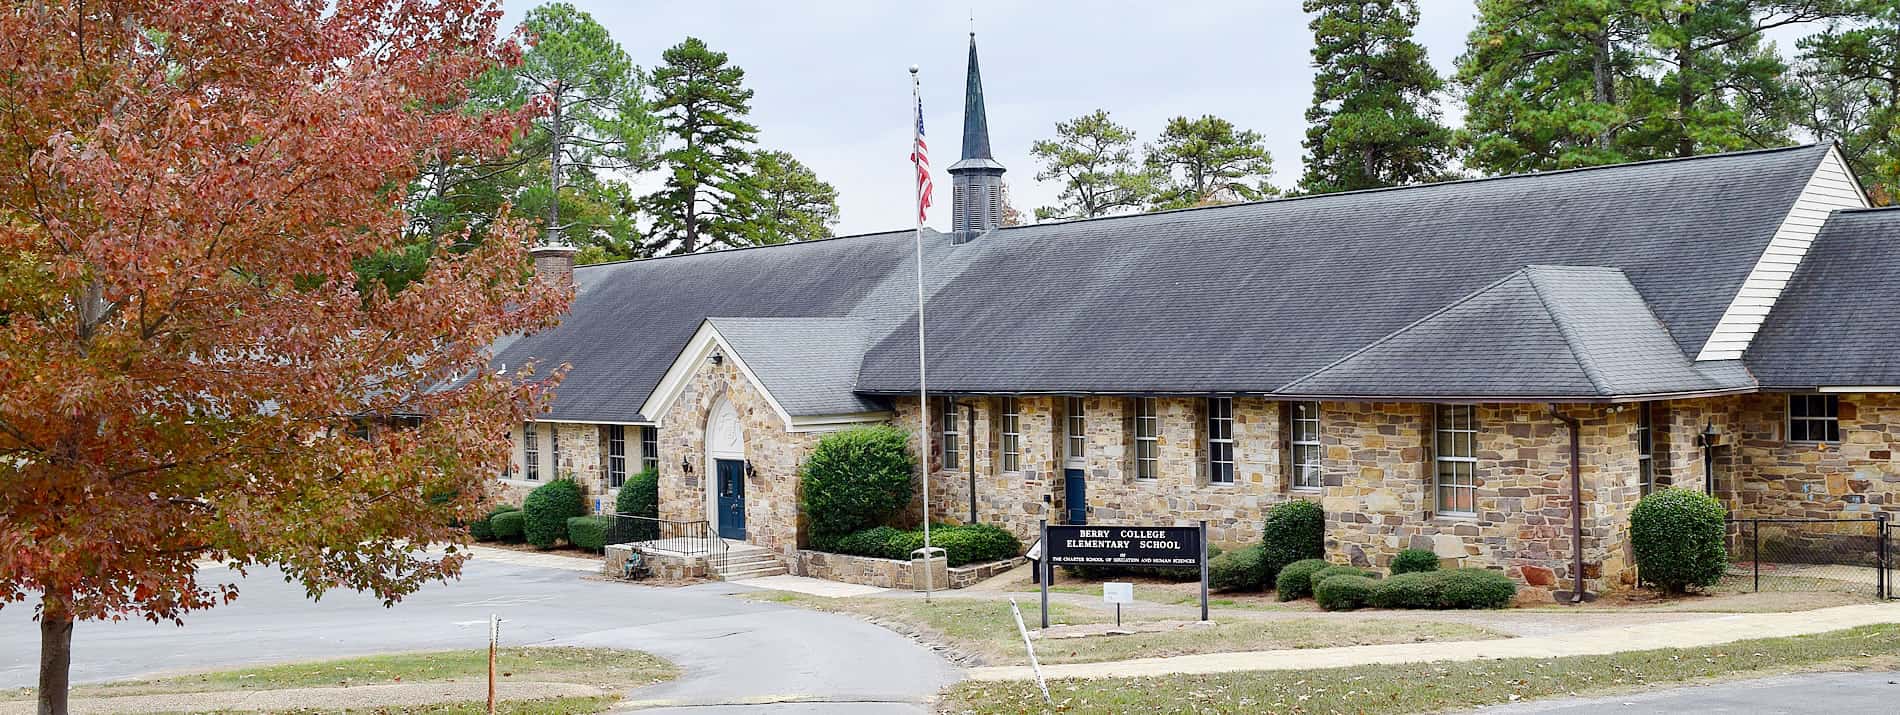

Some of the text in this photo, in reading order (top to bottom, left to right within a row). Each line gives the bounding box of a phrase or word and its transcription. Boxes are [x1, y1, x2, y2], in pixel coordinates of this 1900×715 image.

[1079, 529, 1166, 539] BERRY COLLEGE
[1066, 539, 1181, 550] ELEMENTARY SCHOOL
